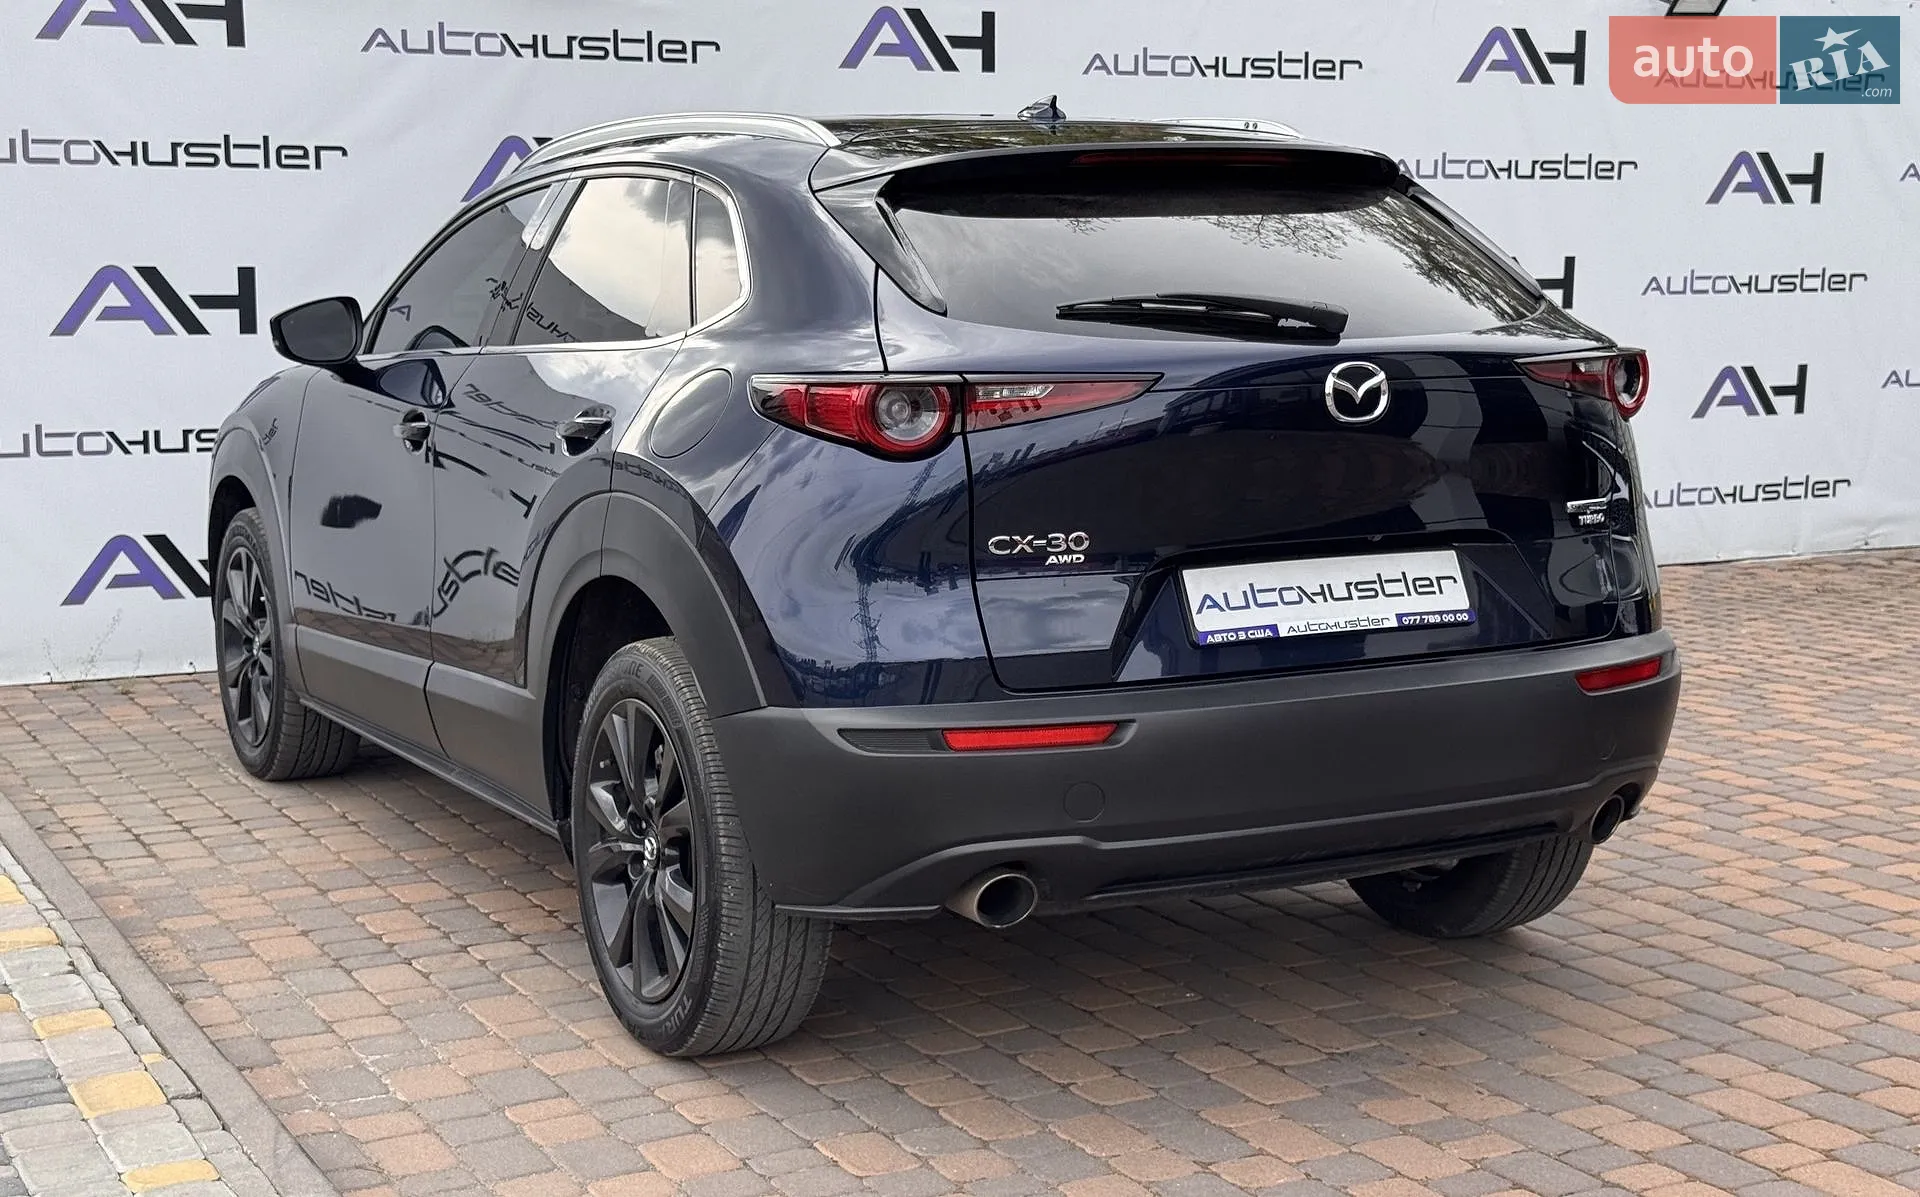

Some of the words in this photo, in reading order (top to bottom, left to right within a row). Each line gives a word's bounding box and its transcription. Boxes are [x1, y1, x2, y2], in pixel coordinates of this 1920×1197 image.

[838, 5, 996, 74] AH
[1457, 26, 1588, 86] AH
[0, 129, 348, 171] utoHustler
[1705, 150, 1825, 205] AH
[50, 265, 258, 337] AH
[1692, 364, 1809, 420] AH
[988, 531, 1090, 555] CX-30
[1045, 554, 1085, 566] AWD
[1247, 628, 1273, 639] США
[1401, 615, 1420, 625] 077
[1421, 614, 1441, 624] 789
[1441, 613, 1455, 622] 00
[1455, 612, 1469, 621] 00
